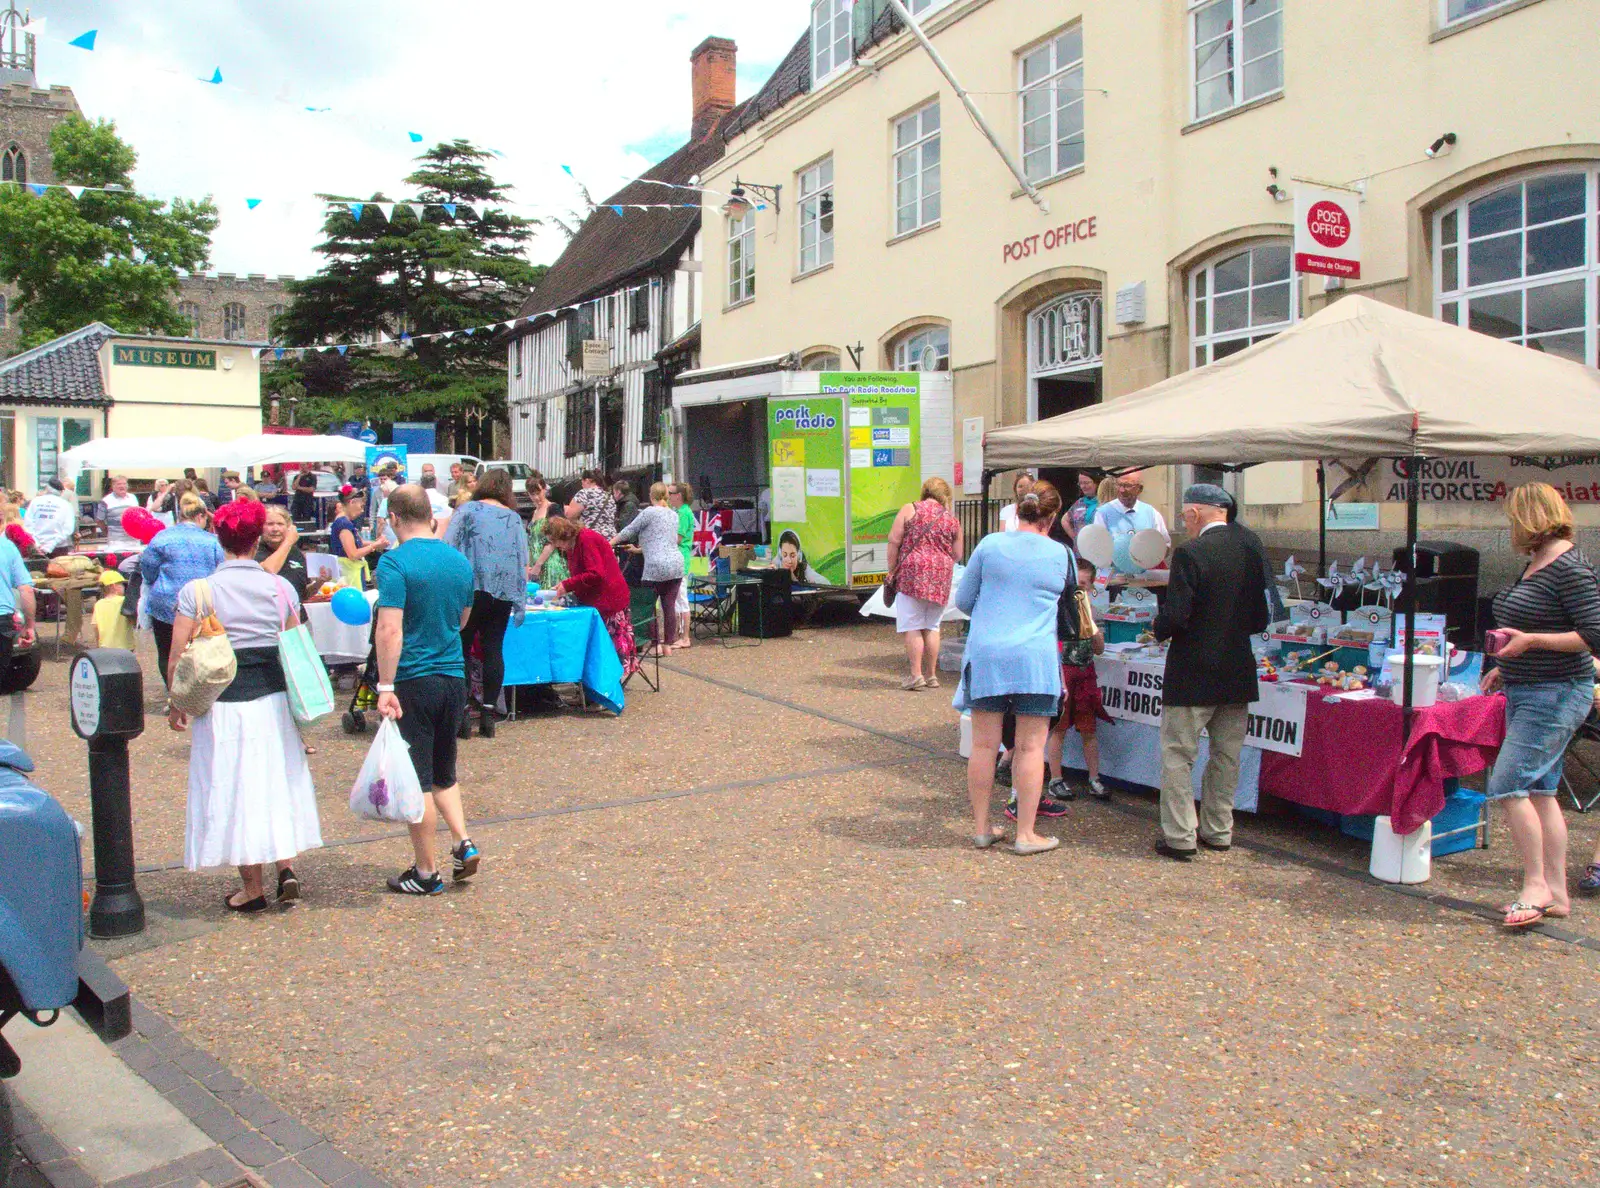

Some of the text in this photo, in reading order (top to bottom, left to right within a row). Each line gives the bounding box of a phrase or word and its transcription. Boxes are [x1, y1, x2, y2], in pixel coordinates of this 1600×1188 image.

[1317, 209, 1342, 225] POST
[1311, 222, 1346, 238] OFFICE
[1003, 215, 1097, 263] POST OFFICE
[1307, 258, 1326, 269] Bureau
[1334, 263, 1353, 273] Change
[119, 349, 212, 366] MUSEUM
[823, 386, 837, 394] The
[839, 386, 856, 394] Park
[857, 386, 879, 394] Radio
[879, 396, 888, 405] By
[775, 404, 810, 423] park
[795, 413, 836, 429] radio
[1420, 460, 1481, 480] ROYAL
[1386, 482, 1414, 501] AI
[1421, 482, 1495, 502] FORCES
[853, 574, 874, 583] MK03
[1127, 671, 1163, 690] DISS
[1124, 690, 1162, 717] FORC
[1245, 713, 1298, 746] ATION
